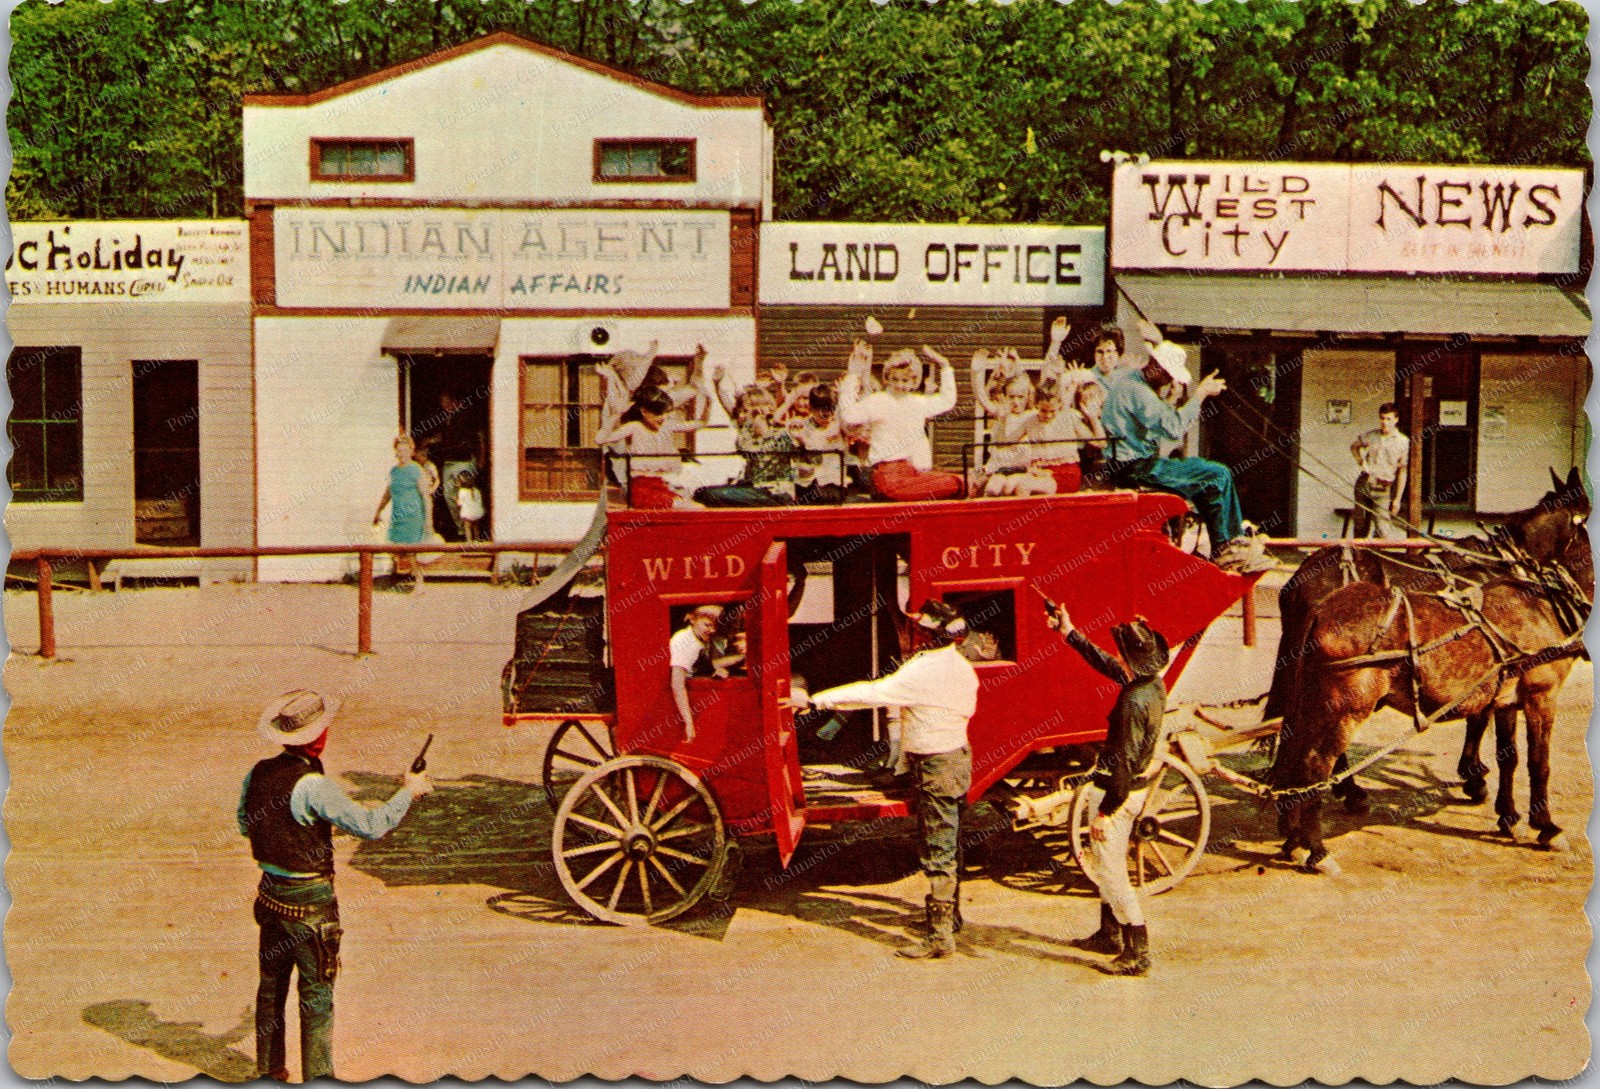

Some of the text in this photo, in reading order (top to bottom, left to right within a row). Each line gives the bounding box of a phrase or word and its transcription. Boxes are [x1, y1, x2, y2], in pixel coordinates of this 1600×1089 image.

[1376, 174, 1561, 233] NEWS
[5, 241, 38, 272] C
[290, 220, 716, 262] INDIAN AGENT
[1162, 212, 1290, 264] City
[403, 273, 623, 295] INDIAN AFFAIRS
[788, 242, 1082, 285] LAND OFFICE
[47, 280, 126, 296] HUMANS
[642, 541, 1037, 582] WILD CITY
